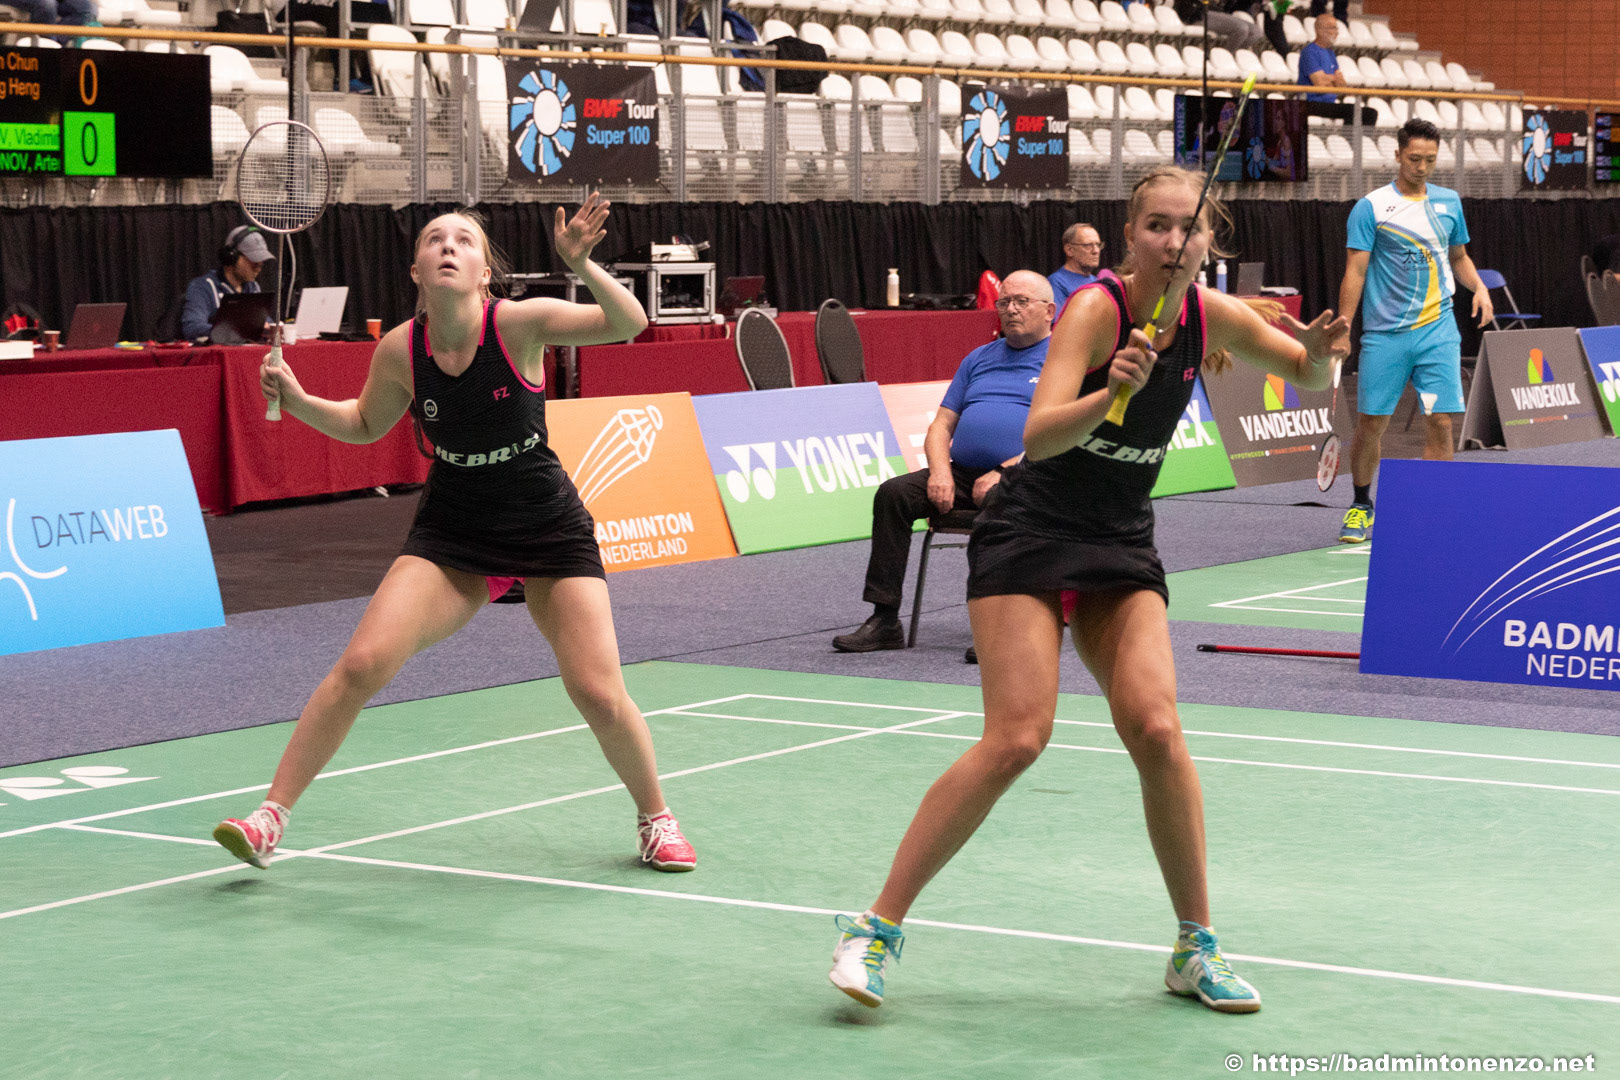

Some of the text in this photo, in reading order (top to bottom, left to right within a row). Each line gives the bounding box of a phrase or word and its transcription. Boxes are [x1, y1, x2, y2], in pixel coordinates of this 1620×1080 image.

[7, 52, 39, 71] Chun
[8, 77, 40, 100] Heng
[79, 58, 98, 105] 0
[583, 98, 656, 119] BWF Tour
[587, 124, 650, 149] Super 100
[1015, 115, 1069, 133] BWF Tour
[82, 122, 97, 166] 0
[1017, 137, 1063, 159] Super 100
[34, 152, 60, 172] Arte
[1183, 367, 1195, 382] FZ
[493, 386, 511, 400] FZ
[1511, 383, 1580, 411] VANDEKOLK
[1239, 407, 1332, 441] VANDEKOLK
[781, 431, 897, 494] YONEX
[31, 504, 168, 549] DATAWEB
[596, 511, 694, 544] ADMINTON
[600, 537, 688, 565] NEDERLAND
[1526, 653, 1620, 681] NEDER
